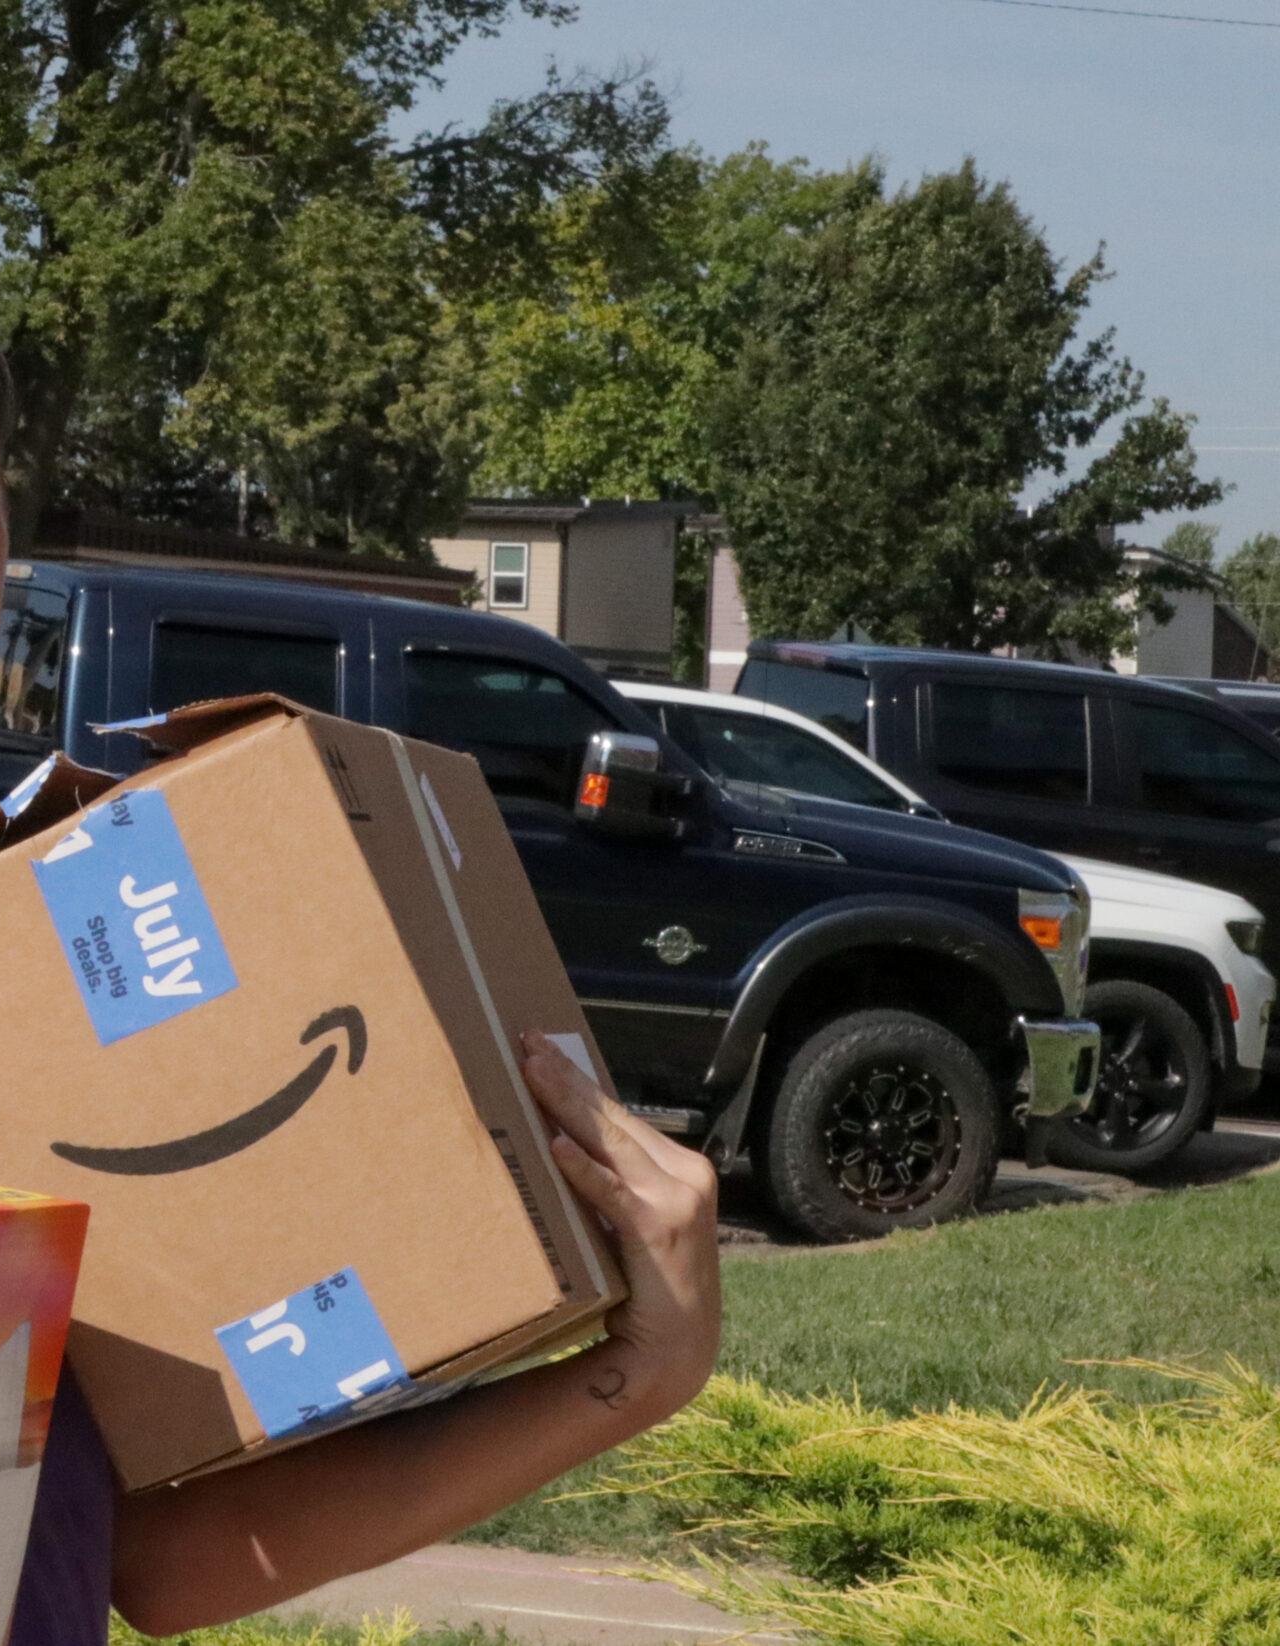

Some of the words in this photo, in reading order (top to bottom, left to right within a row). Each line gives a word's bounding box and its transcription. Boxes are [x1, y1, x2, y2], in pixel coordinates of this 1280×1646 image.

[71, 936, 104, 995] deals.
[86, 914, 115, 965] Shop
[106, 965, 128, 999] big
[119, 874, 203, 997] July
